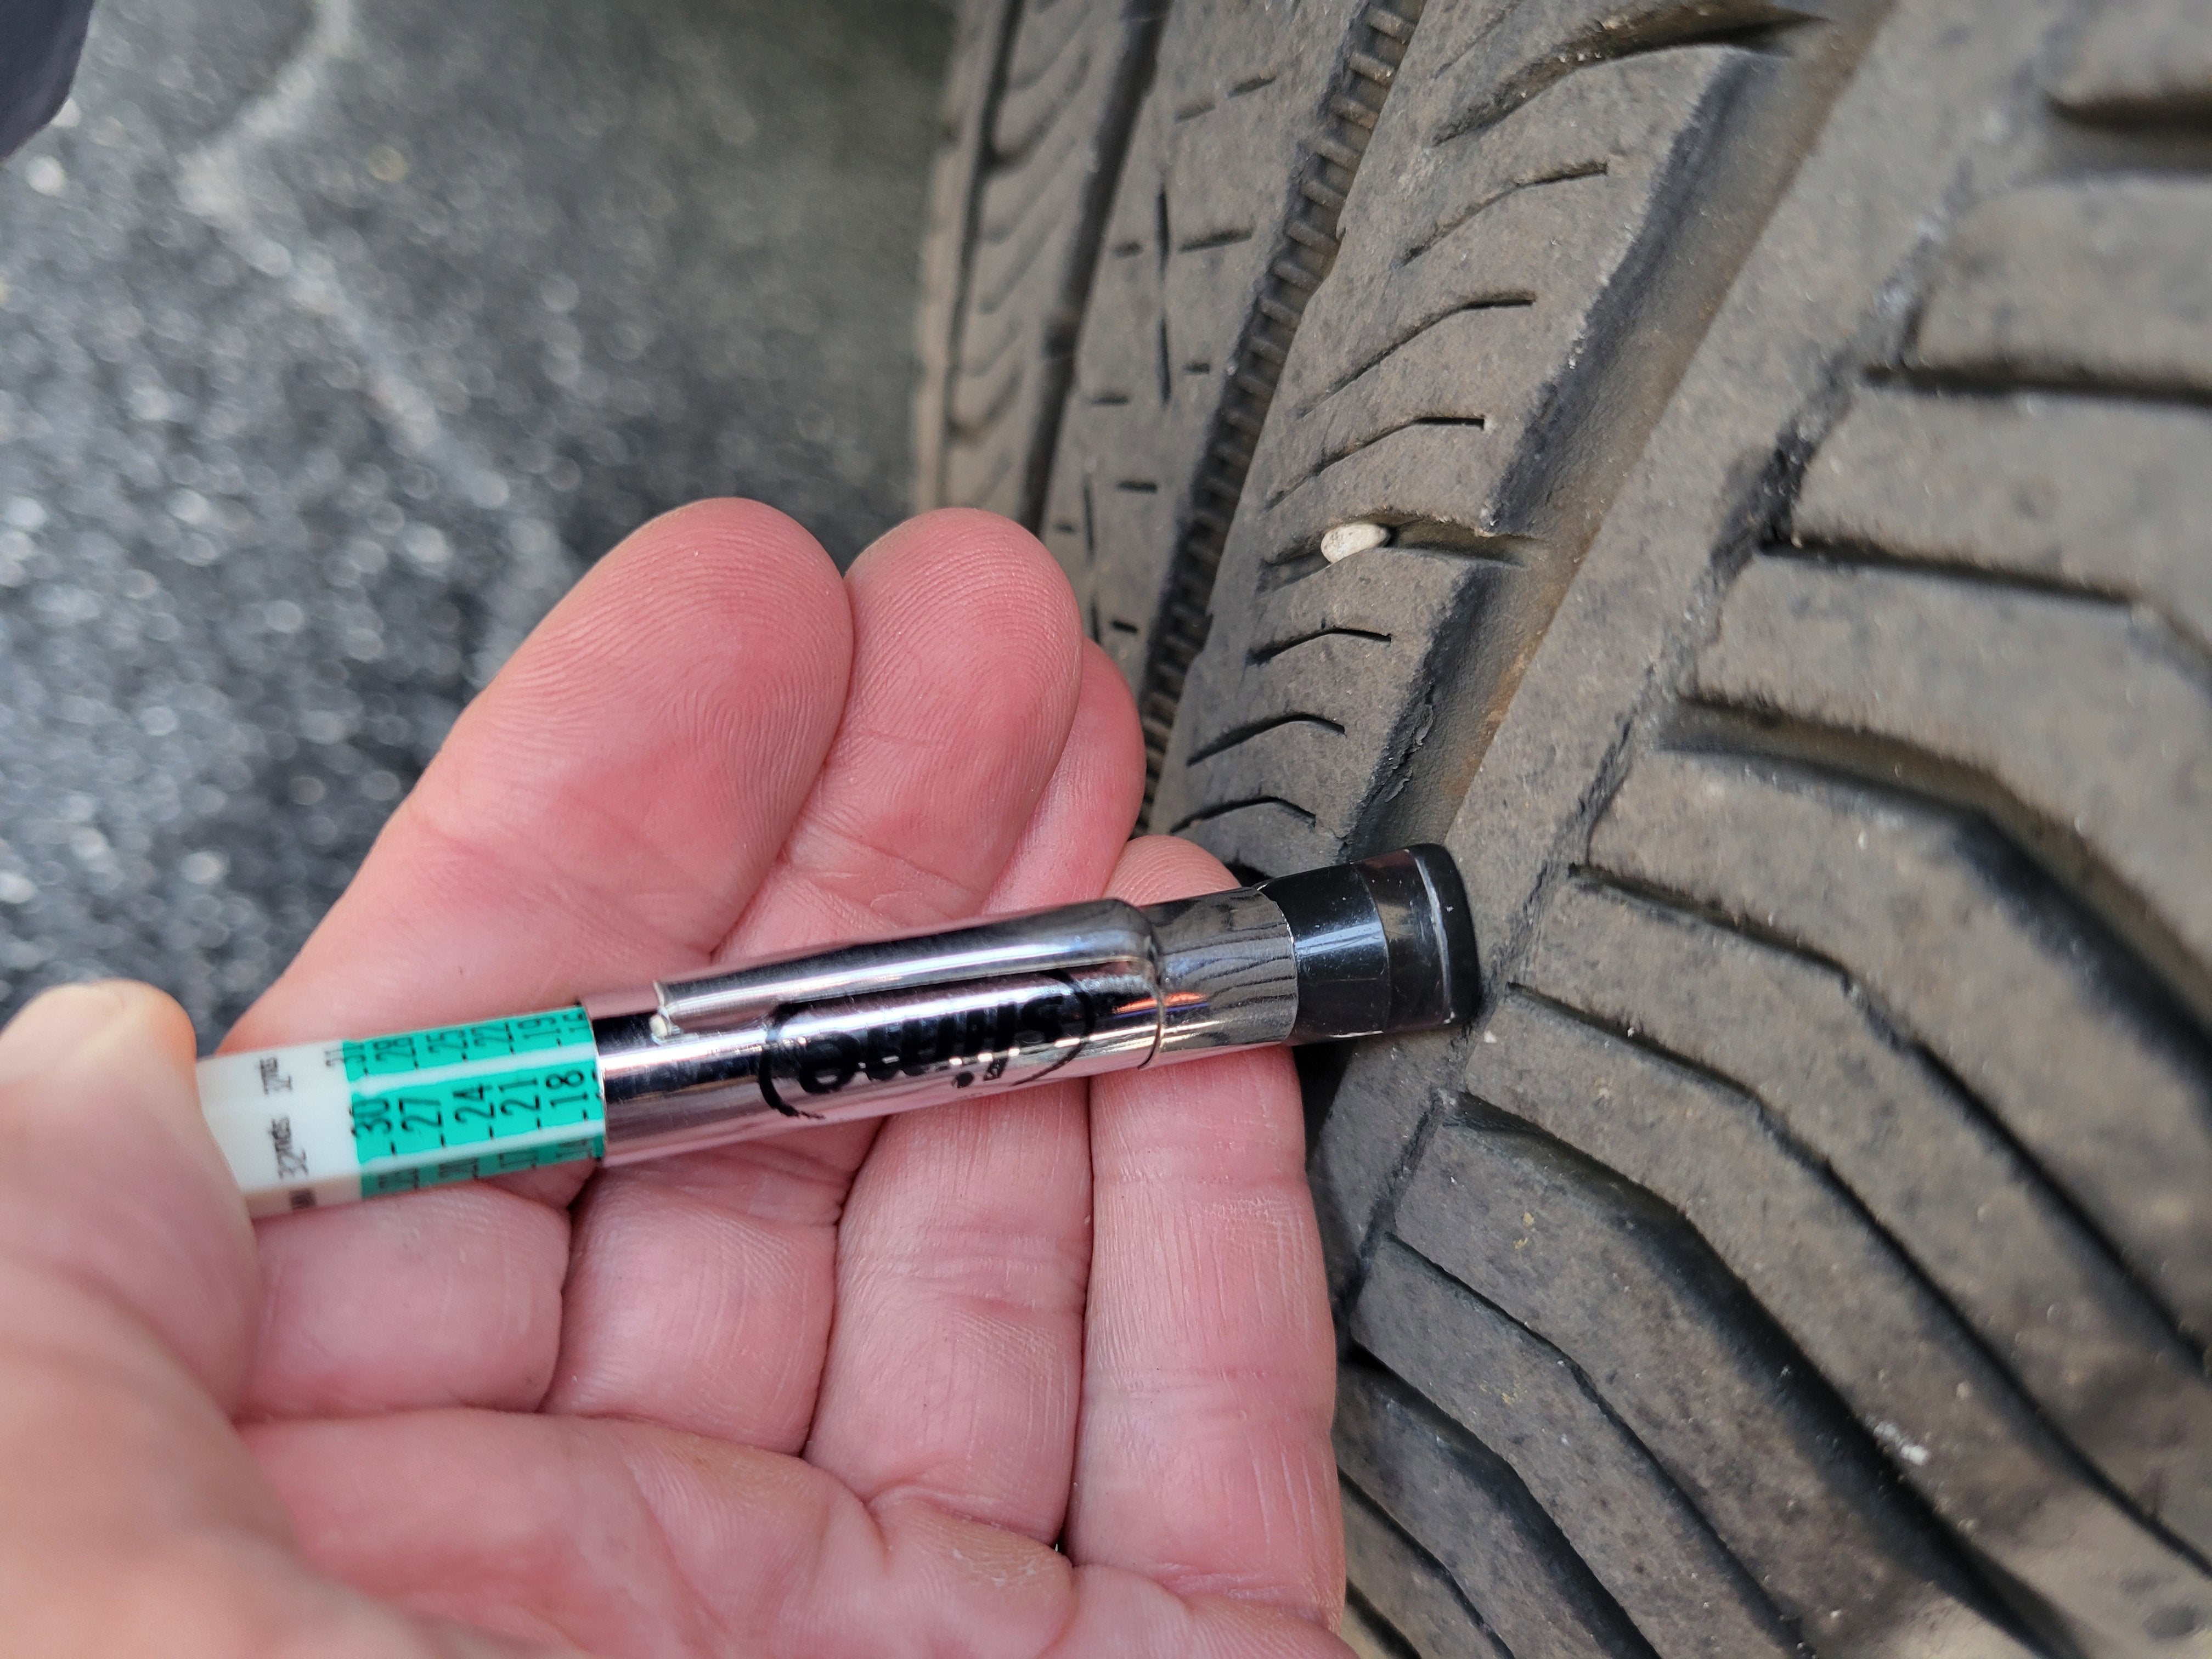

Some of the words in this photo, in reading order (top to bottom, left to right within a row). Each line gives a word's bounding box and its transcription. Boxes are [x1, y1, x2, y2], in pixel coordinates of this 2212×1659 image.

[425, 1028, 468, 1054] 25
[470, 1022, 514, 1047] 22
[517, 1016, 561, 1040] 19
[324, 1043, 366, 1068] 31
[372, 1036, 416, 1062] 28
[453, 1082, 495, 1124] 24
[498, 1077, 541, 1116] 21
[546, 1070, 589, 1108] 18
[348, 1097, 392, 1138] 30
[397, 1097, 443, 1133] 27
